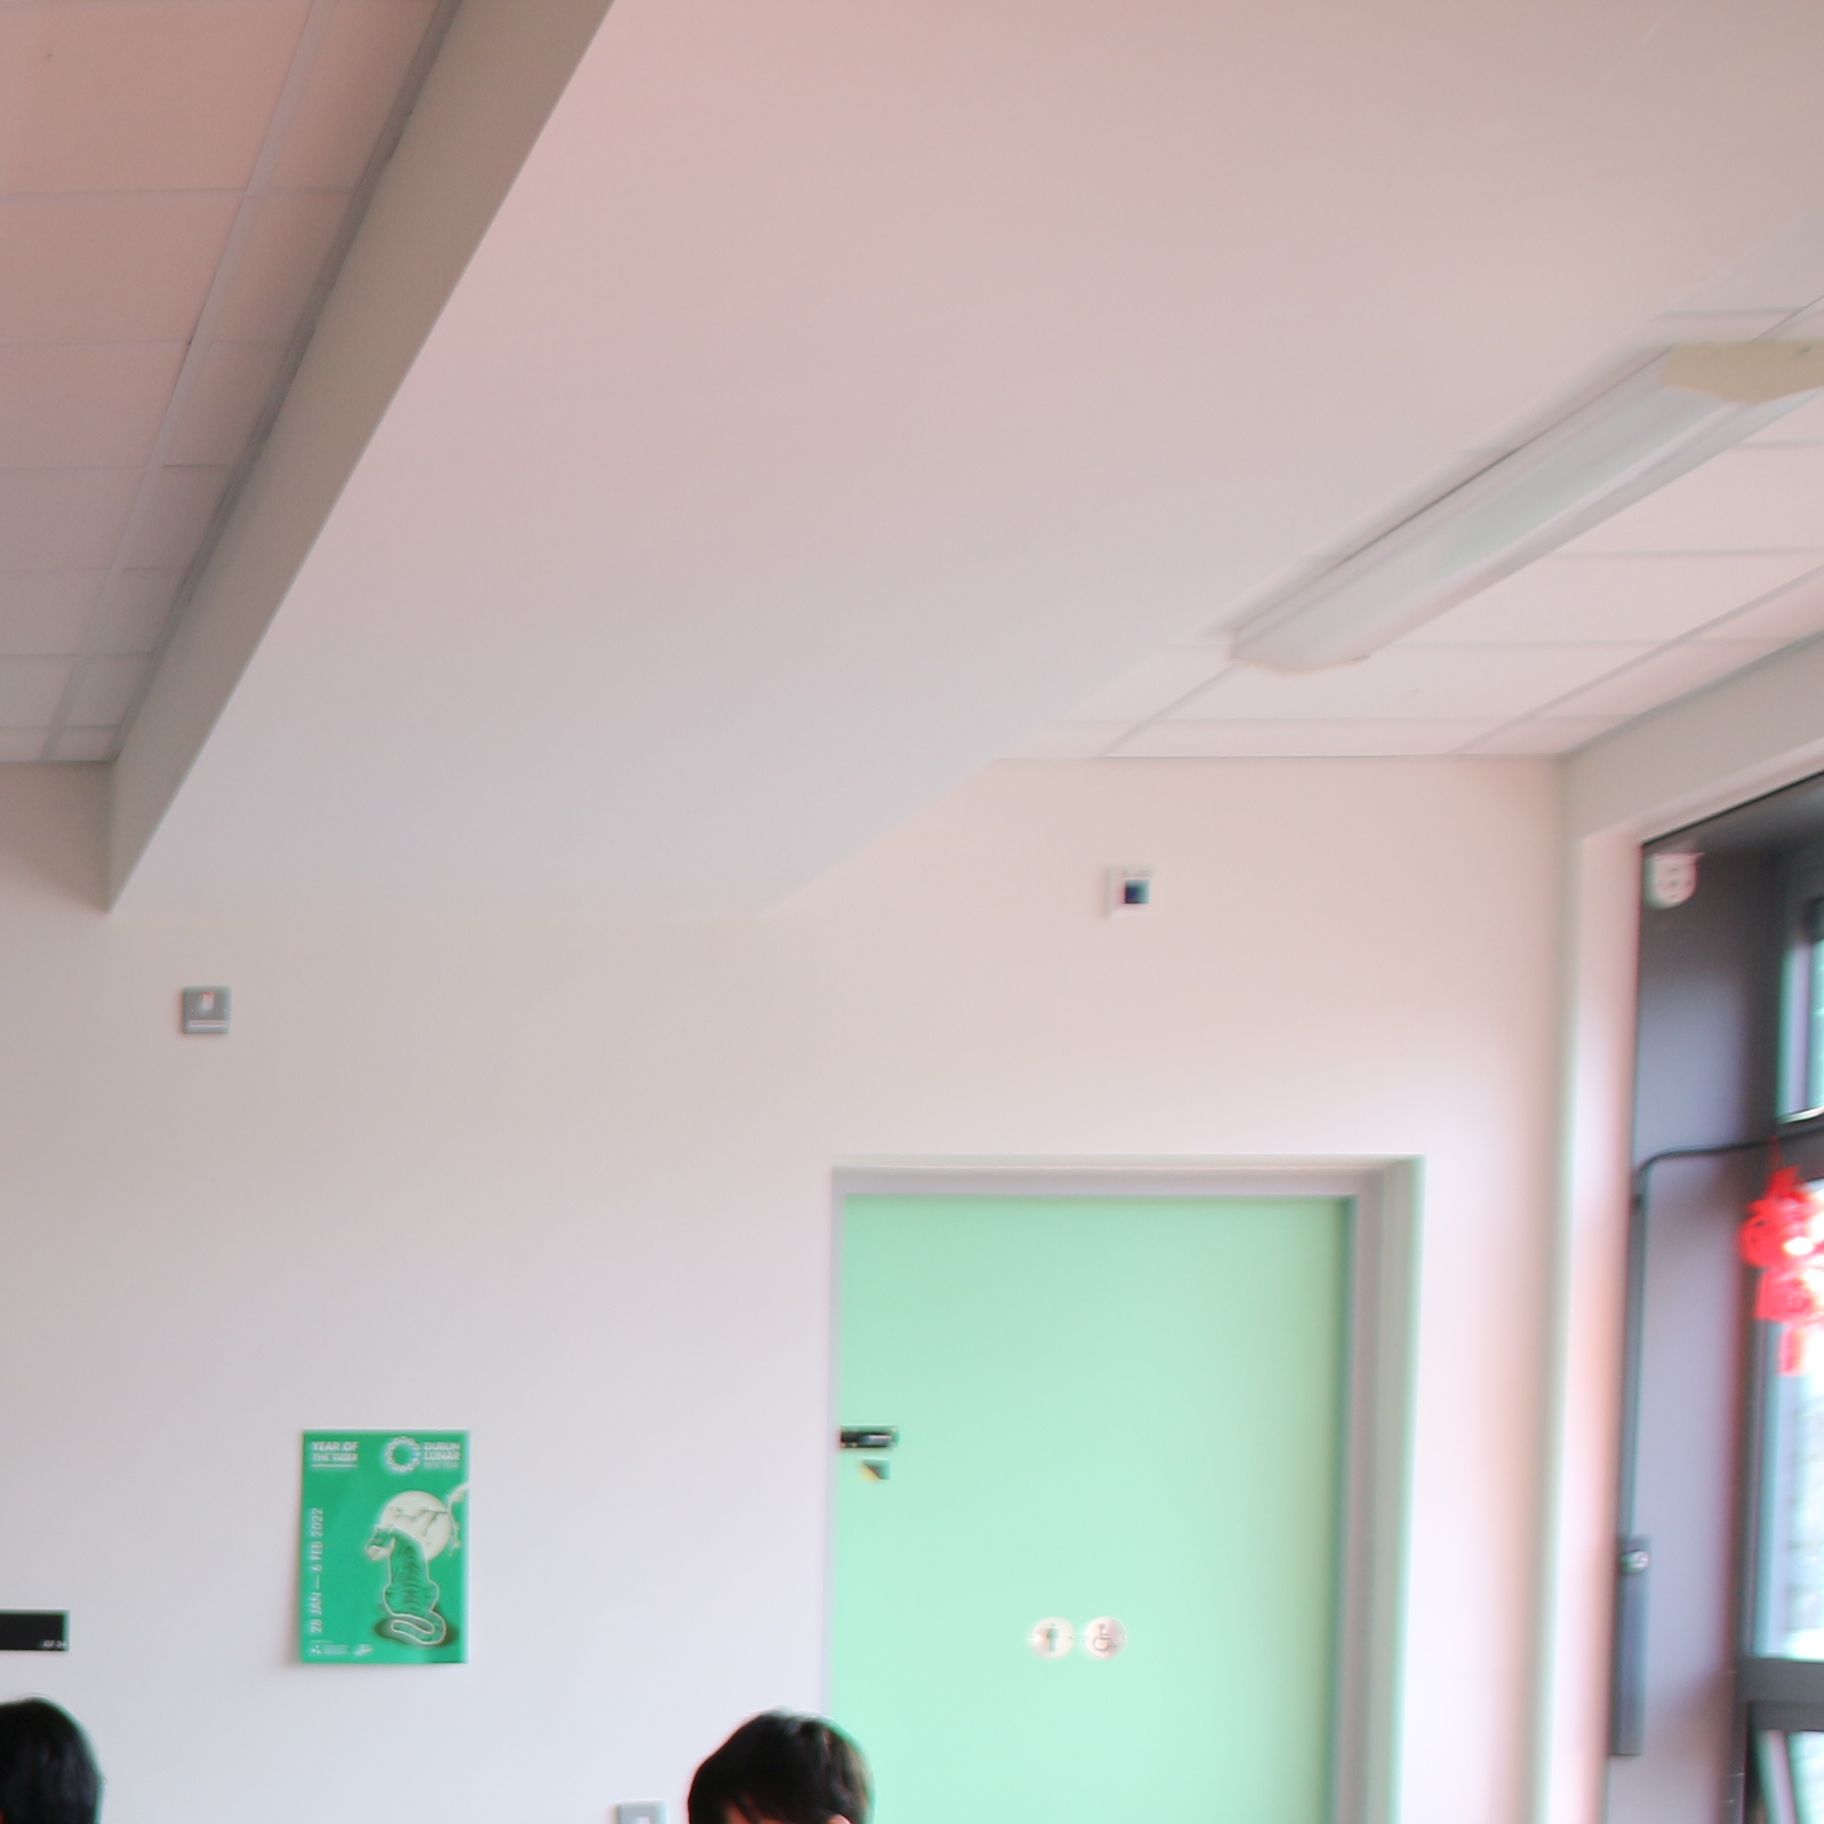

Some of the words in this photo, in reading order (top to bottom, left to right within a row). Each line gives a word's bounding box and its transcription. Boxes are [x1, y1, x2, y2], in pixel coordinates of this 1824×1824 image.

[312, 1441, 339, 1451] YEAR
[342, 1441, 359, 1451] OF
[310, 1507, 323, 1538] 2022
